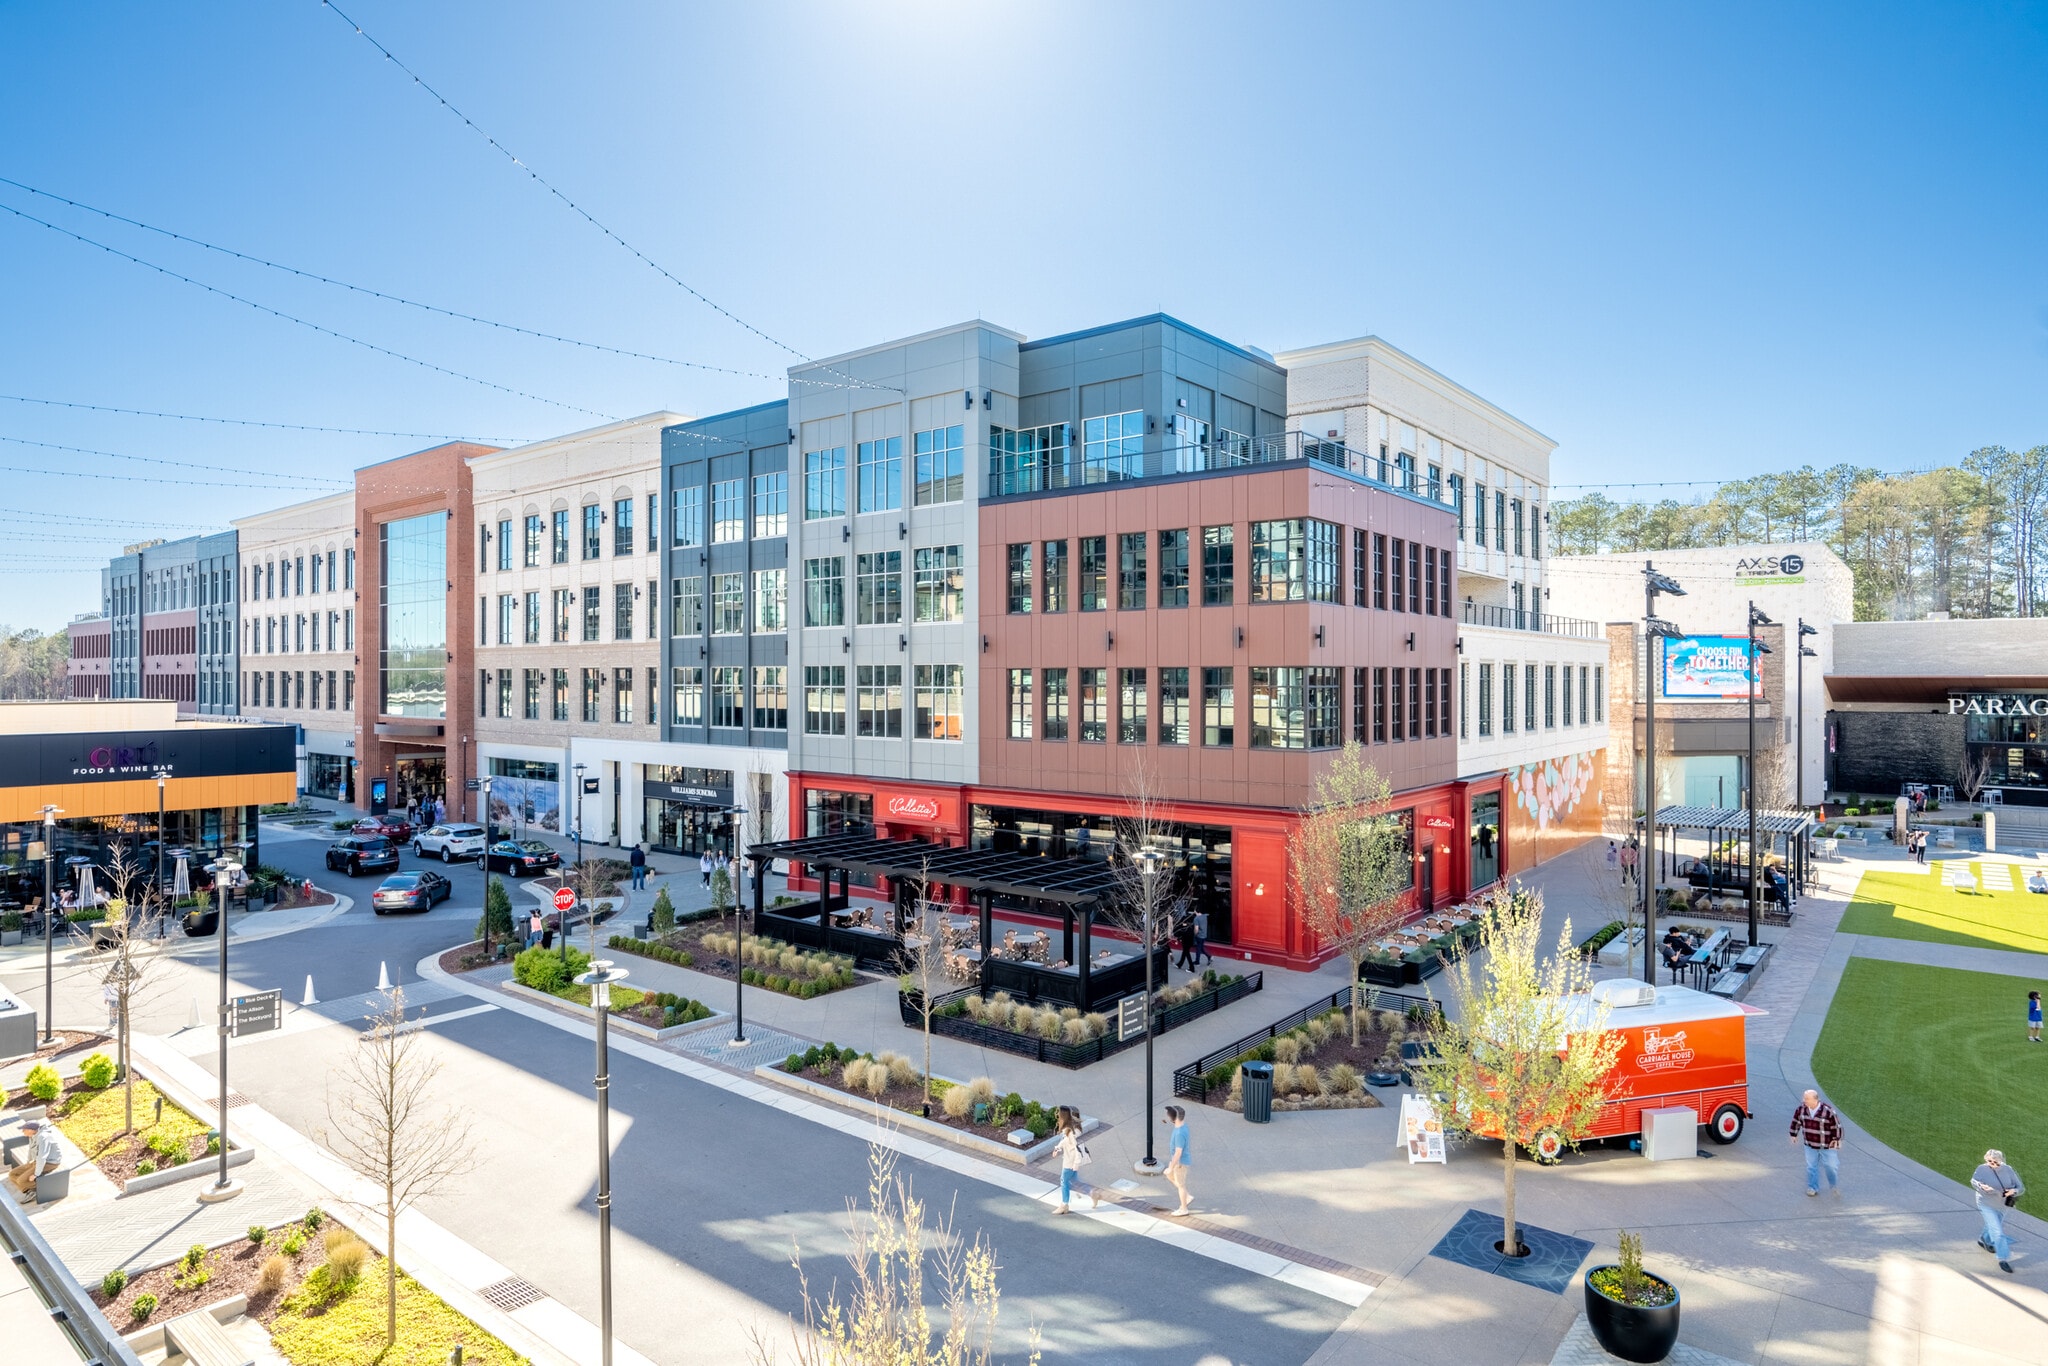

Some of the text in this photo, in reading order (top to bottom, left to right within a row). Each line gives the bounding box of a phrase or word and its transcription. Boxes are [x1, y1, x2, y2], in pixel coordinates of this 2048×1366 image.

[1696, 646, 1743, 656] CHOOSE FUN
[1947, 698, 2048, 716] PARAG
[89, 741, 157, 768] CRÚ
[120, 765, 148, 773] WINE
[894, 798, 931, 814] Colletta
[555, 894, 573, 905] STOP
[1639, 1051, 1691, 1064] CARRIAGE HOUSE
